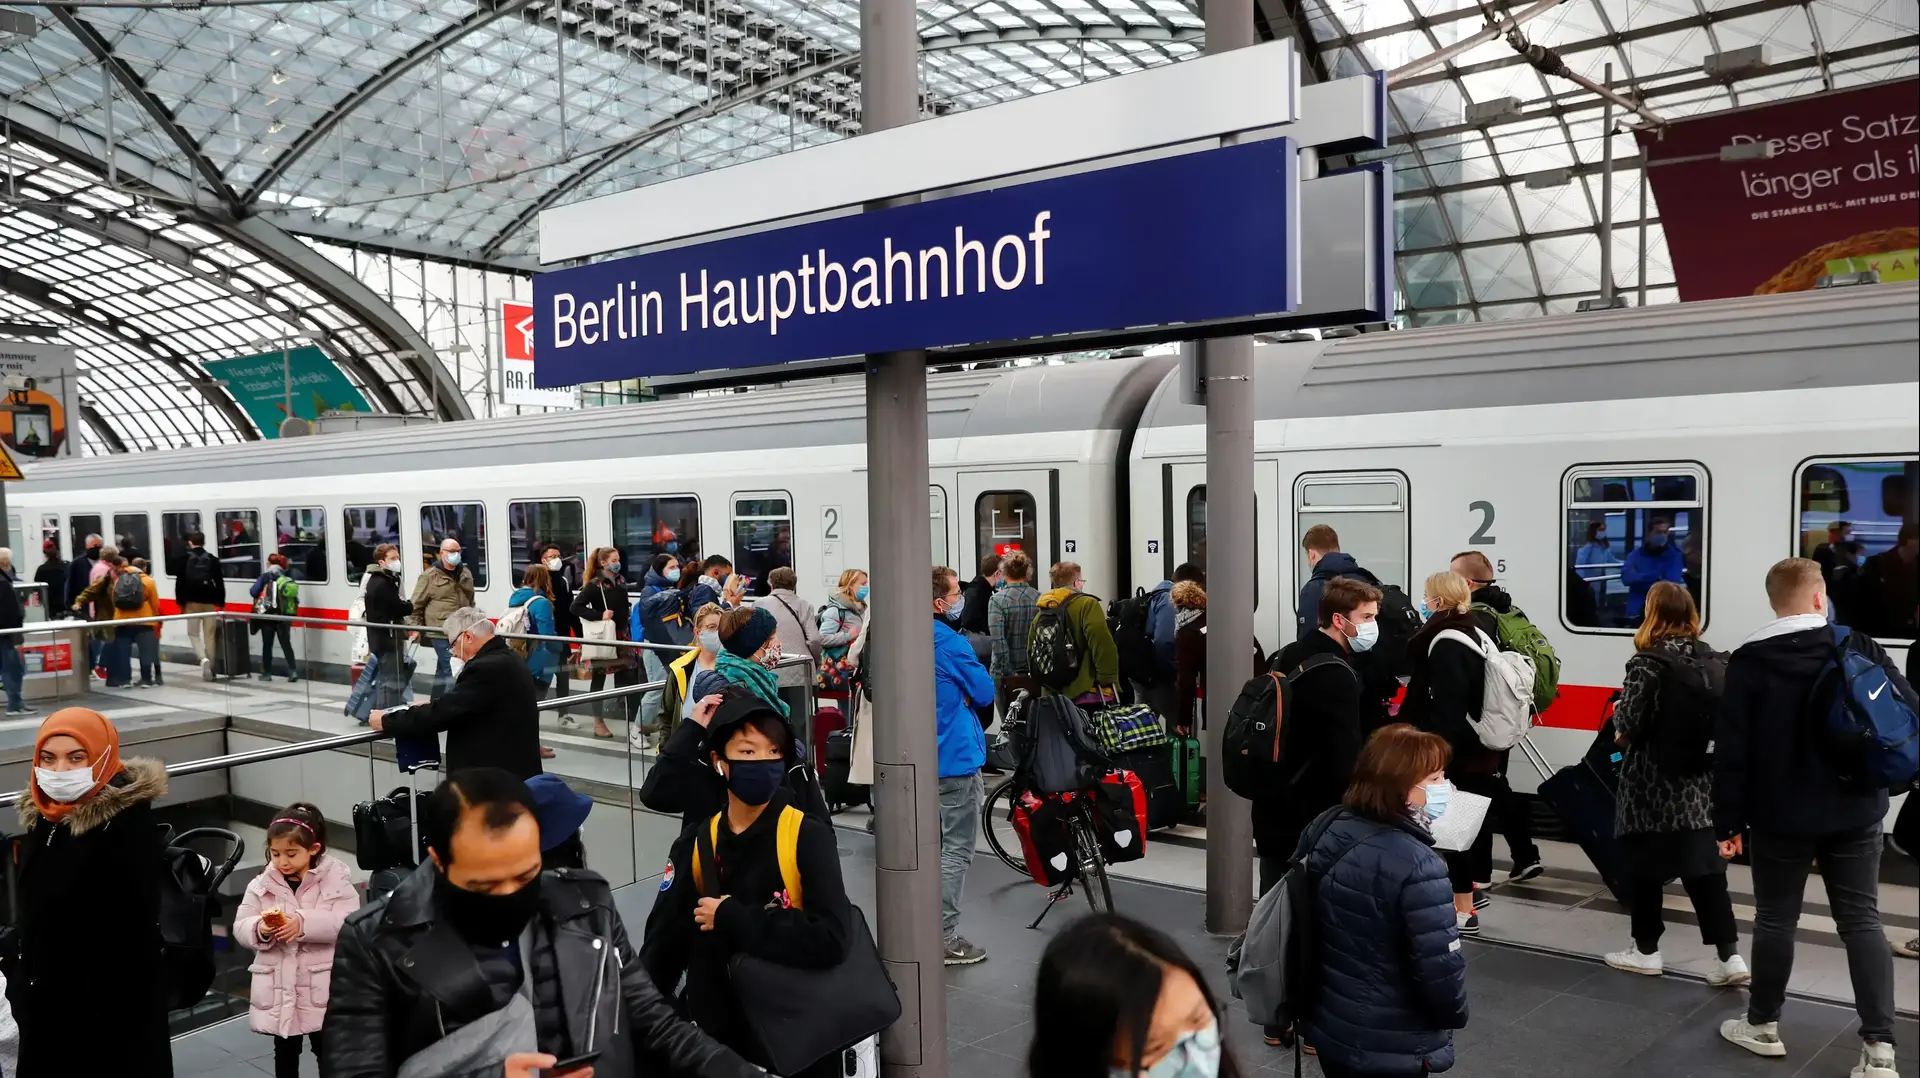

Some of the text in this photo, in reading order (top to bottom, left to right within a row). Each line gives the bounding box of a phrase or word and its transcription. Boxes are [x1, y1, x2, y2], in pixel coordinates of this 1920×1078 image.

[1731, 113, 1919, 156] eser Satz
[1740, 143, 1919, 200] länger als i
[1751, 210, 1769, 221] DIE
[1771, 204, 1814, 218] STARKE
[1845, 197, 1867, 208] MIT
[1869, 193, 1897, 205] NUR
[1899, 189, 1919, 201] DR
[553, 210, 1051, 349] Berlin Hauptbahnhof
[824, 507, 839, 539] 2
[1468, 500, 1496, 545] 2
[1497, 559, 1506, 573] 5
